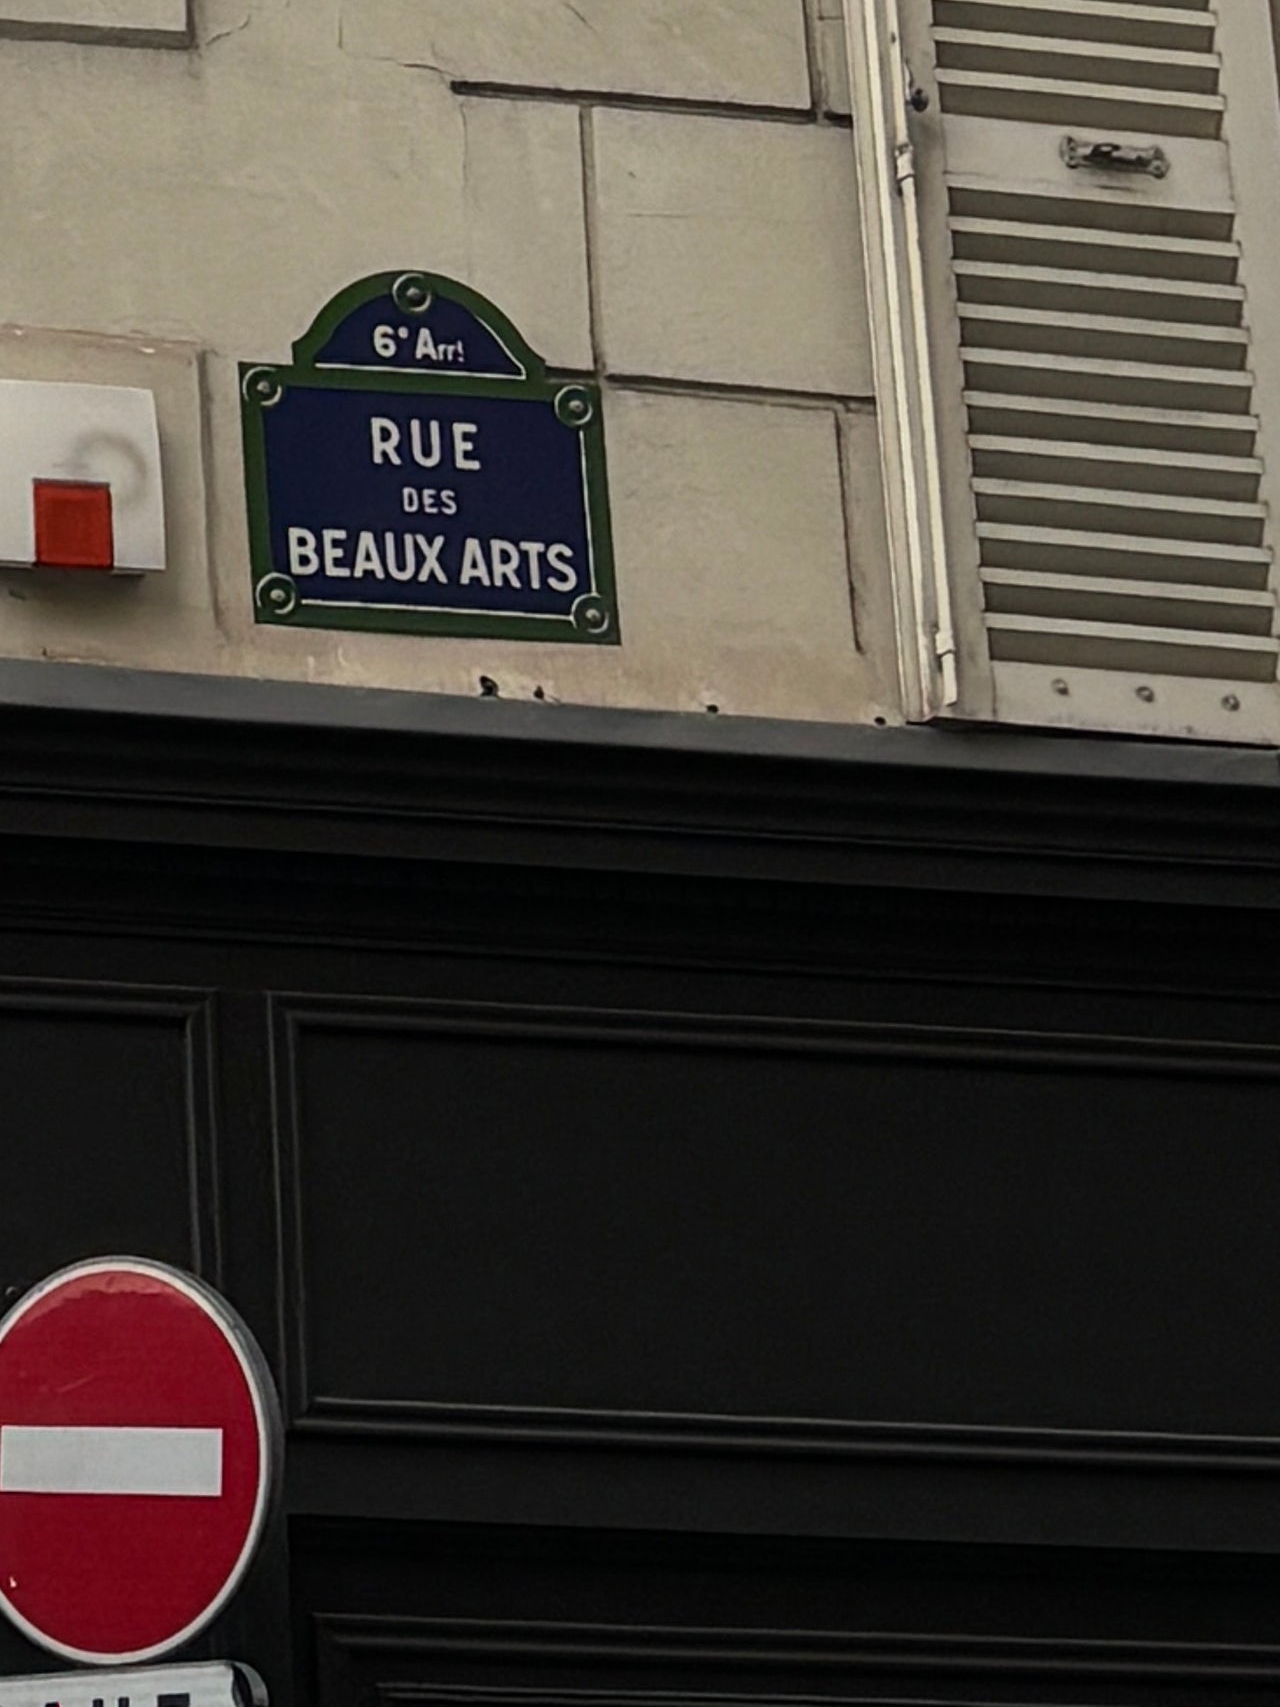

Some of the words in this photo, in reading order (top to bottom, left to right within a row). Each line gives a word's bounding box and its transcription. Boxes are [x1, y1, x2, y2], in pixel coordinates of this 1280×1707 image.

[369, 416, 482, 472] RUE
[401, 485, 458, 516] DES
[287, 526, 449, 585] BEAUX
[459, 536, 578, 593] ARTS
